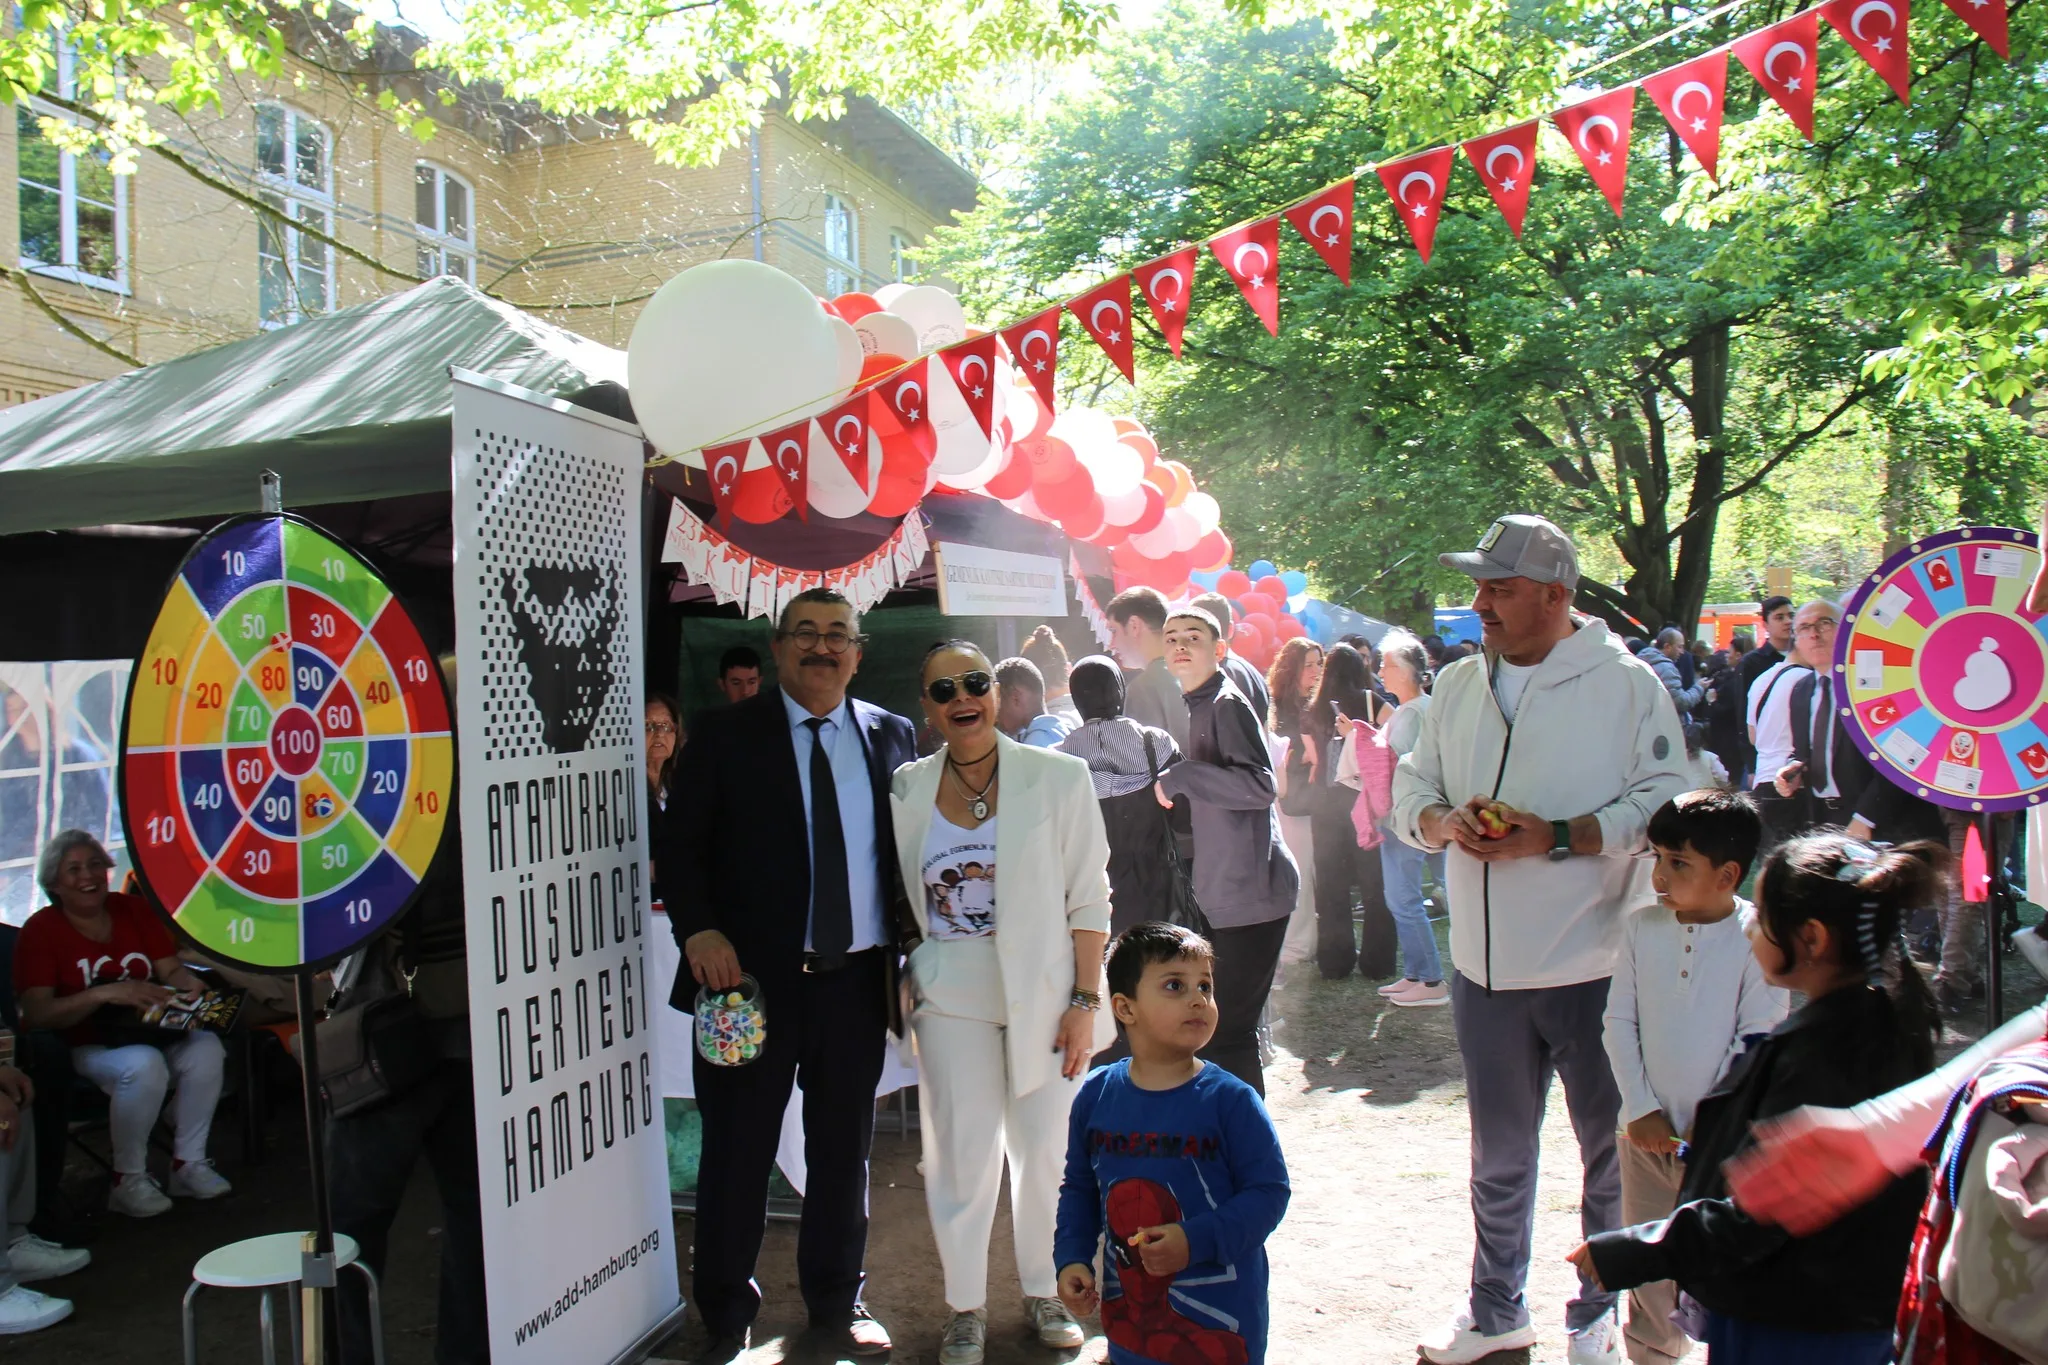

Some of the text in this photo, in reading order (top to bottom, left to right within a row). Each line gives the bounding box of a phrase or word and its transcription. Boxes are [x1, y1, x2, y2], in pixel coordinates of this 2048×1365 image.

[222, 550, 246, 576] 10
[321, 558, 345, 583] 10
[242, 614, 266, 639] 50
[310, 614, 335, 638] 30
[152, 658, 178, 685] 10
[262, 666, 286, 691] 80
[297, 666, 323, 691] 90
[404, 659, 428, 682] 10
[196, 682, 222, 709] 20
[366, 681, 391, 705] 40
[236, 705, 261, 731] 70
[326, 705, 352, 729] 60
[277, 729, 315, 755] 100
[237, 758, 263, 784] 60
[329, 751, 355, 776] 70
[372, 770, 398, 794] 20
[193, 783, 222, 810] 40
[264, 796, 291, 822] 90
[305, 793, 330, 818] 8
[415, 791, 438, 814] 10
[487, 753, 637, 872] ATATÜRKÇÜ
[147, 816, 176, 844] 10
[244, 849, 271, 876] 30
[322, 844, 348, 870] 50
[344, 898, 372, 926] 10
[491, 861, 642, 985] DÜŞÜNCE
[226, 917, 255, 944] 10
[497, 943, 647, 1097] DERNEĞİ
[503, 1051, 652, 1208] HAMBURG
[514, 1229, 660, 1347] www.add-hamburg.org
